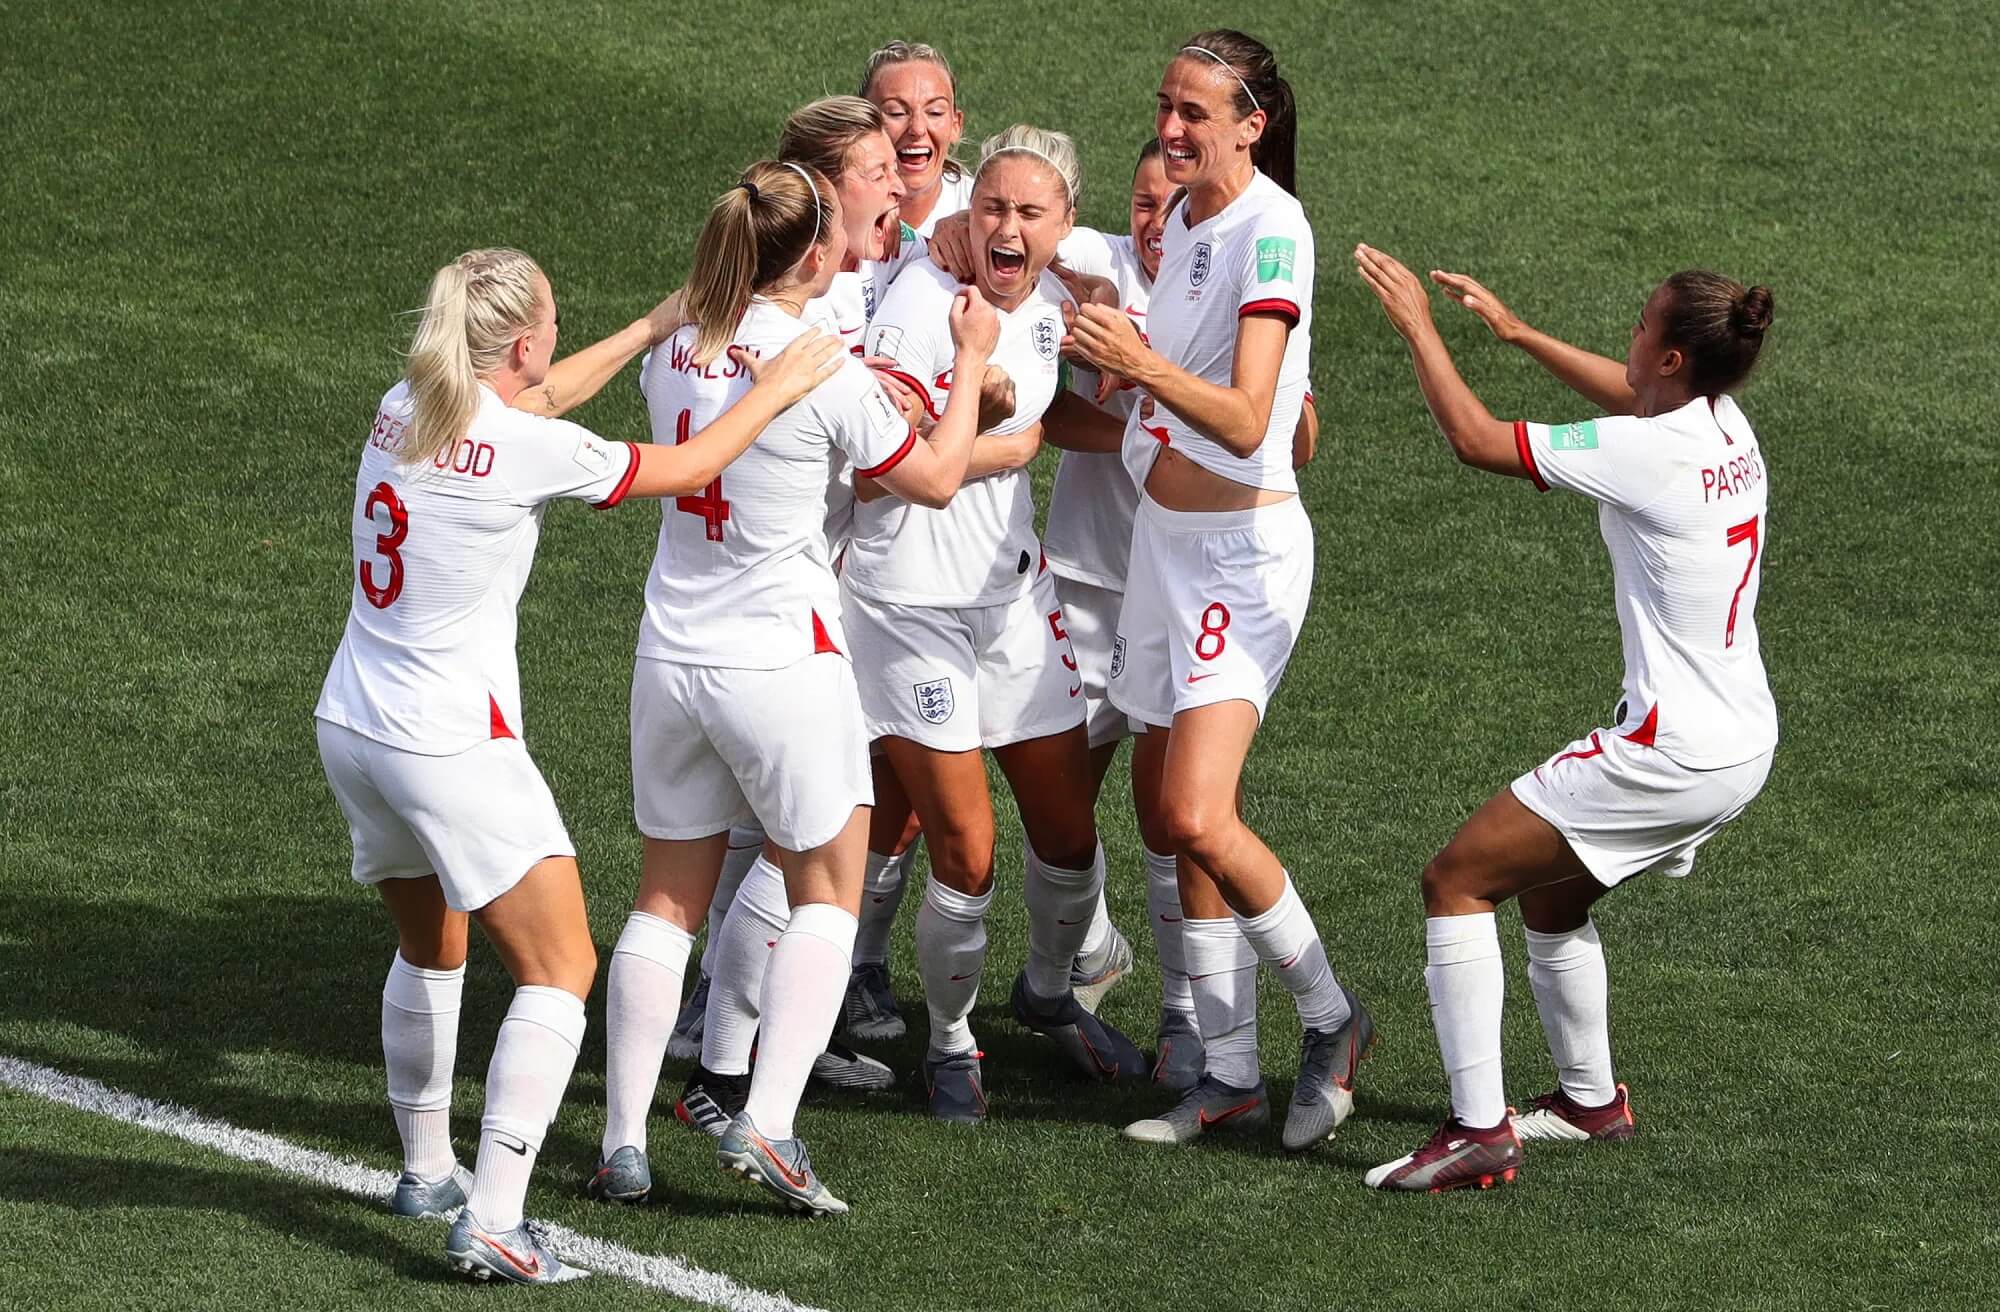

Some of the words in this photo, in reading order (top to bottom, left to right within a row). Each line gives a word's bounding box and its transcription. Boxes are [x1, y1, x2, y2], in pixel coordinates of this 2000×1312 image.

[676, 408, 730, 542] 4
[1701, 447, 1761, 503] PARRIS
[360, 481, 409, 610] 3
[1725, 514, 1759, 649] 7
[1048, 609, 1077, 672] 5
[1195, 601, 1232, 661] 8
[1551, 731, 1604, 769] 7
